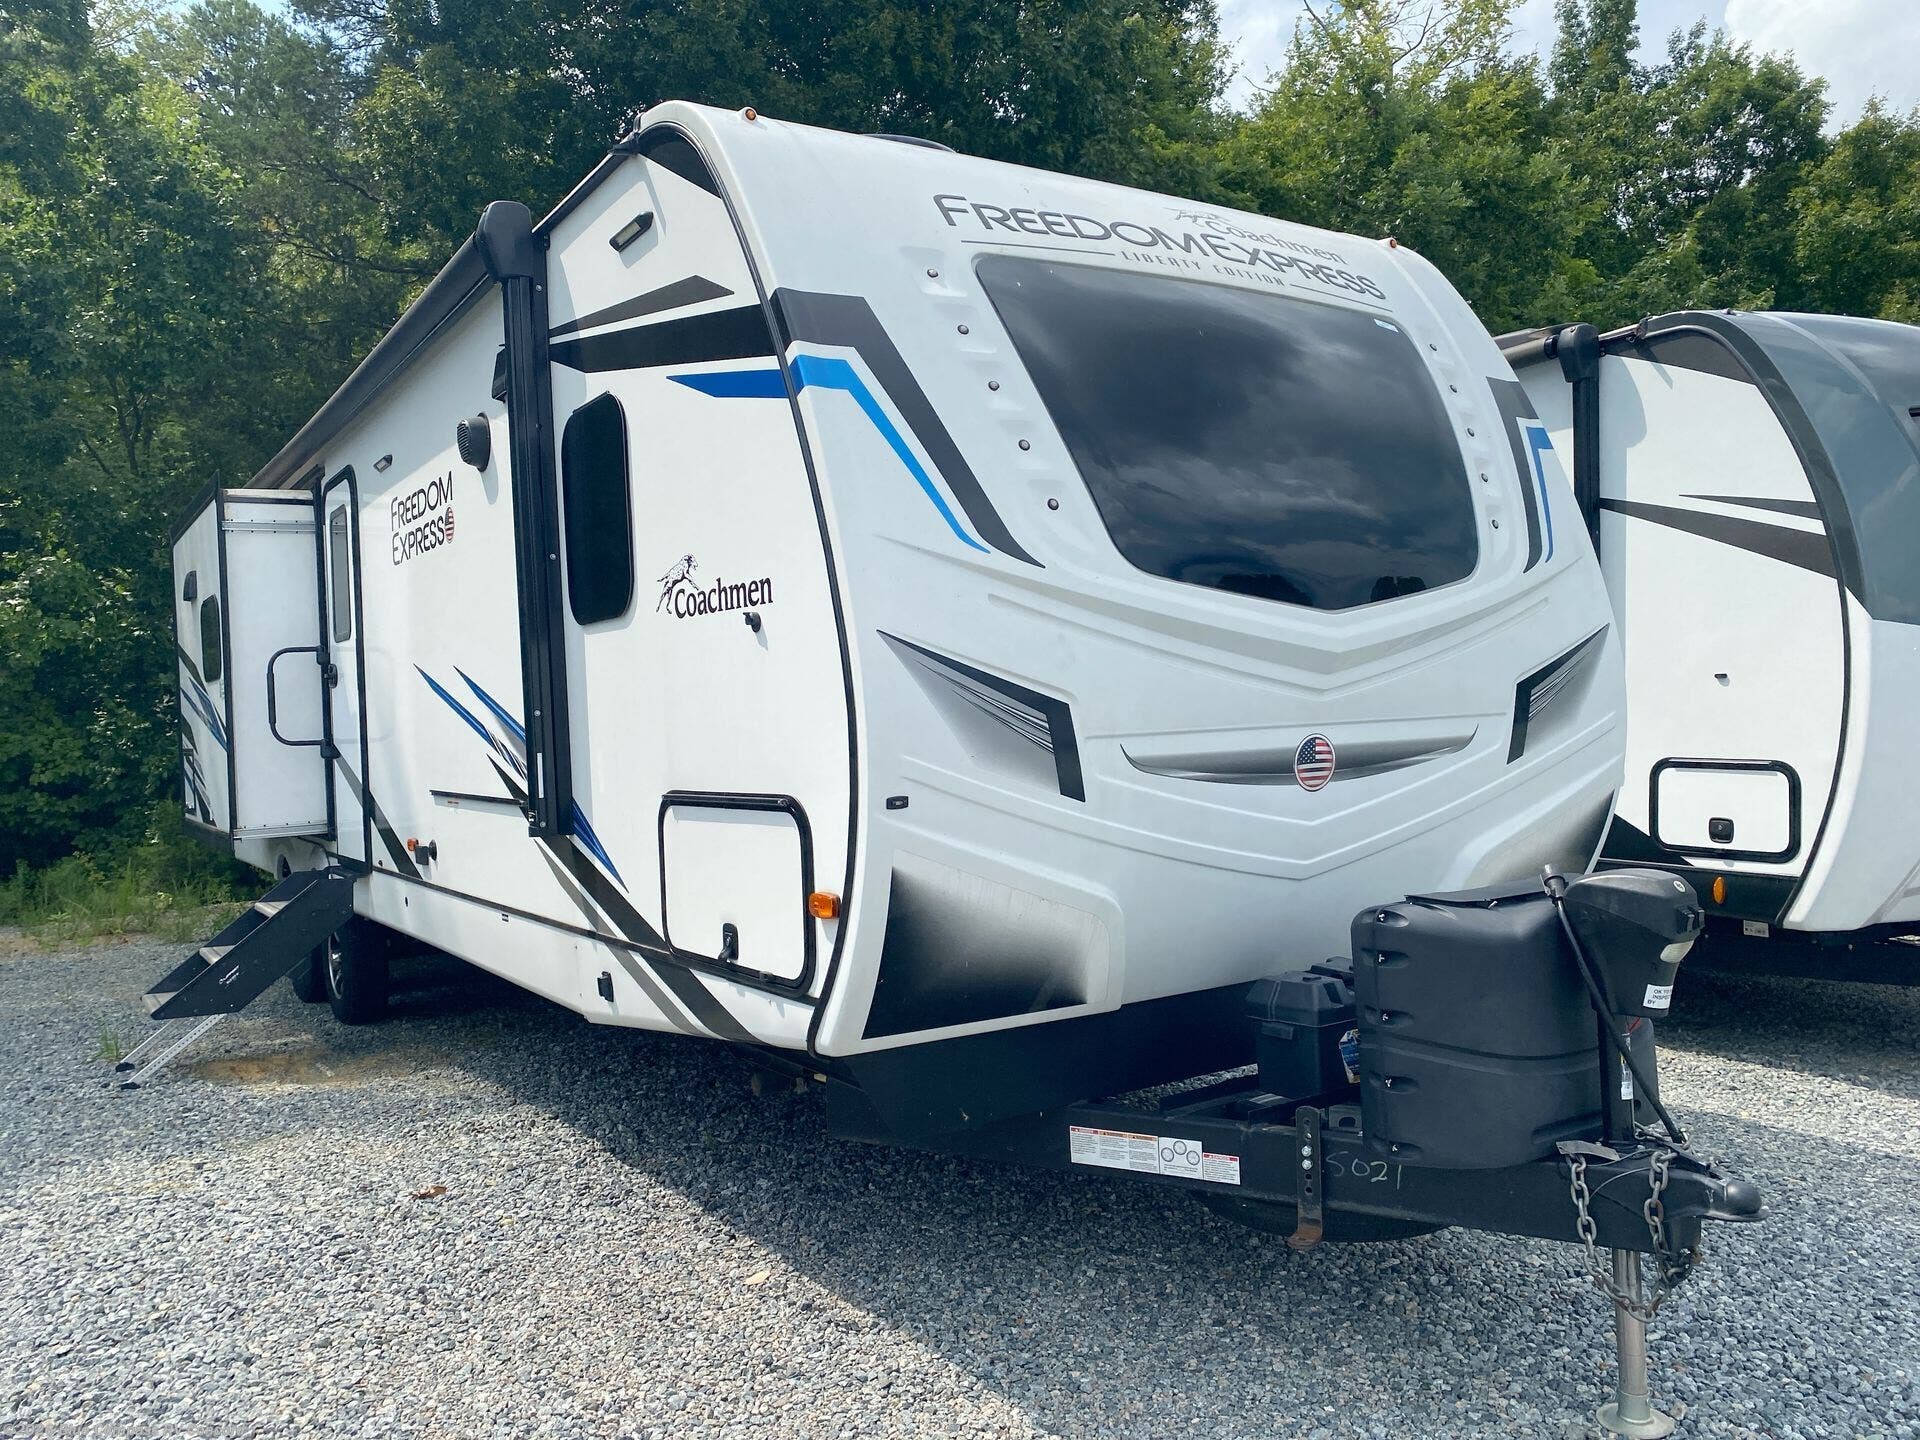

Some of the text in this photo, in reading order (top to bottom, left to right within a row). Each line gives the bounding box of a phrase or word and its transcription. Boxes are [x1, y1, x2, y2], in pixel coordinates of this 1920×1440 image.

[1206, 219, 1348, 265] Coachmen
[1121, 250, 1286, 287] LIBERTY EDITION
[391, 471, 453, 531] FREEDOM
[392, 515, 445, 565] EXPRESS
[674, 577, 774, 619] Coachmen
